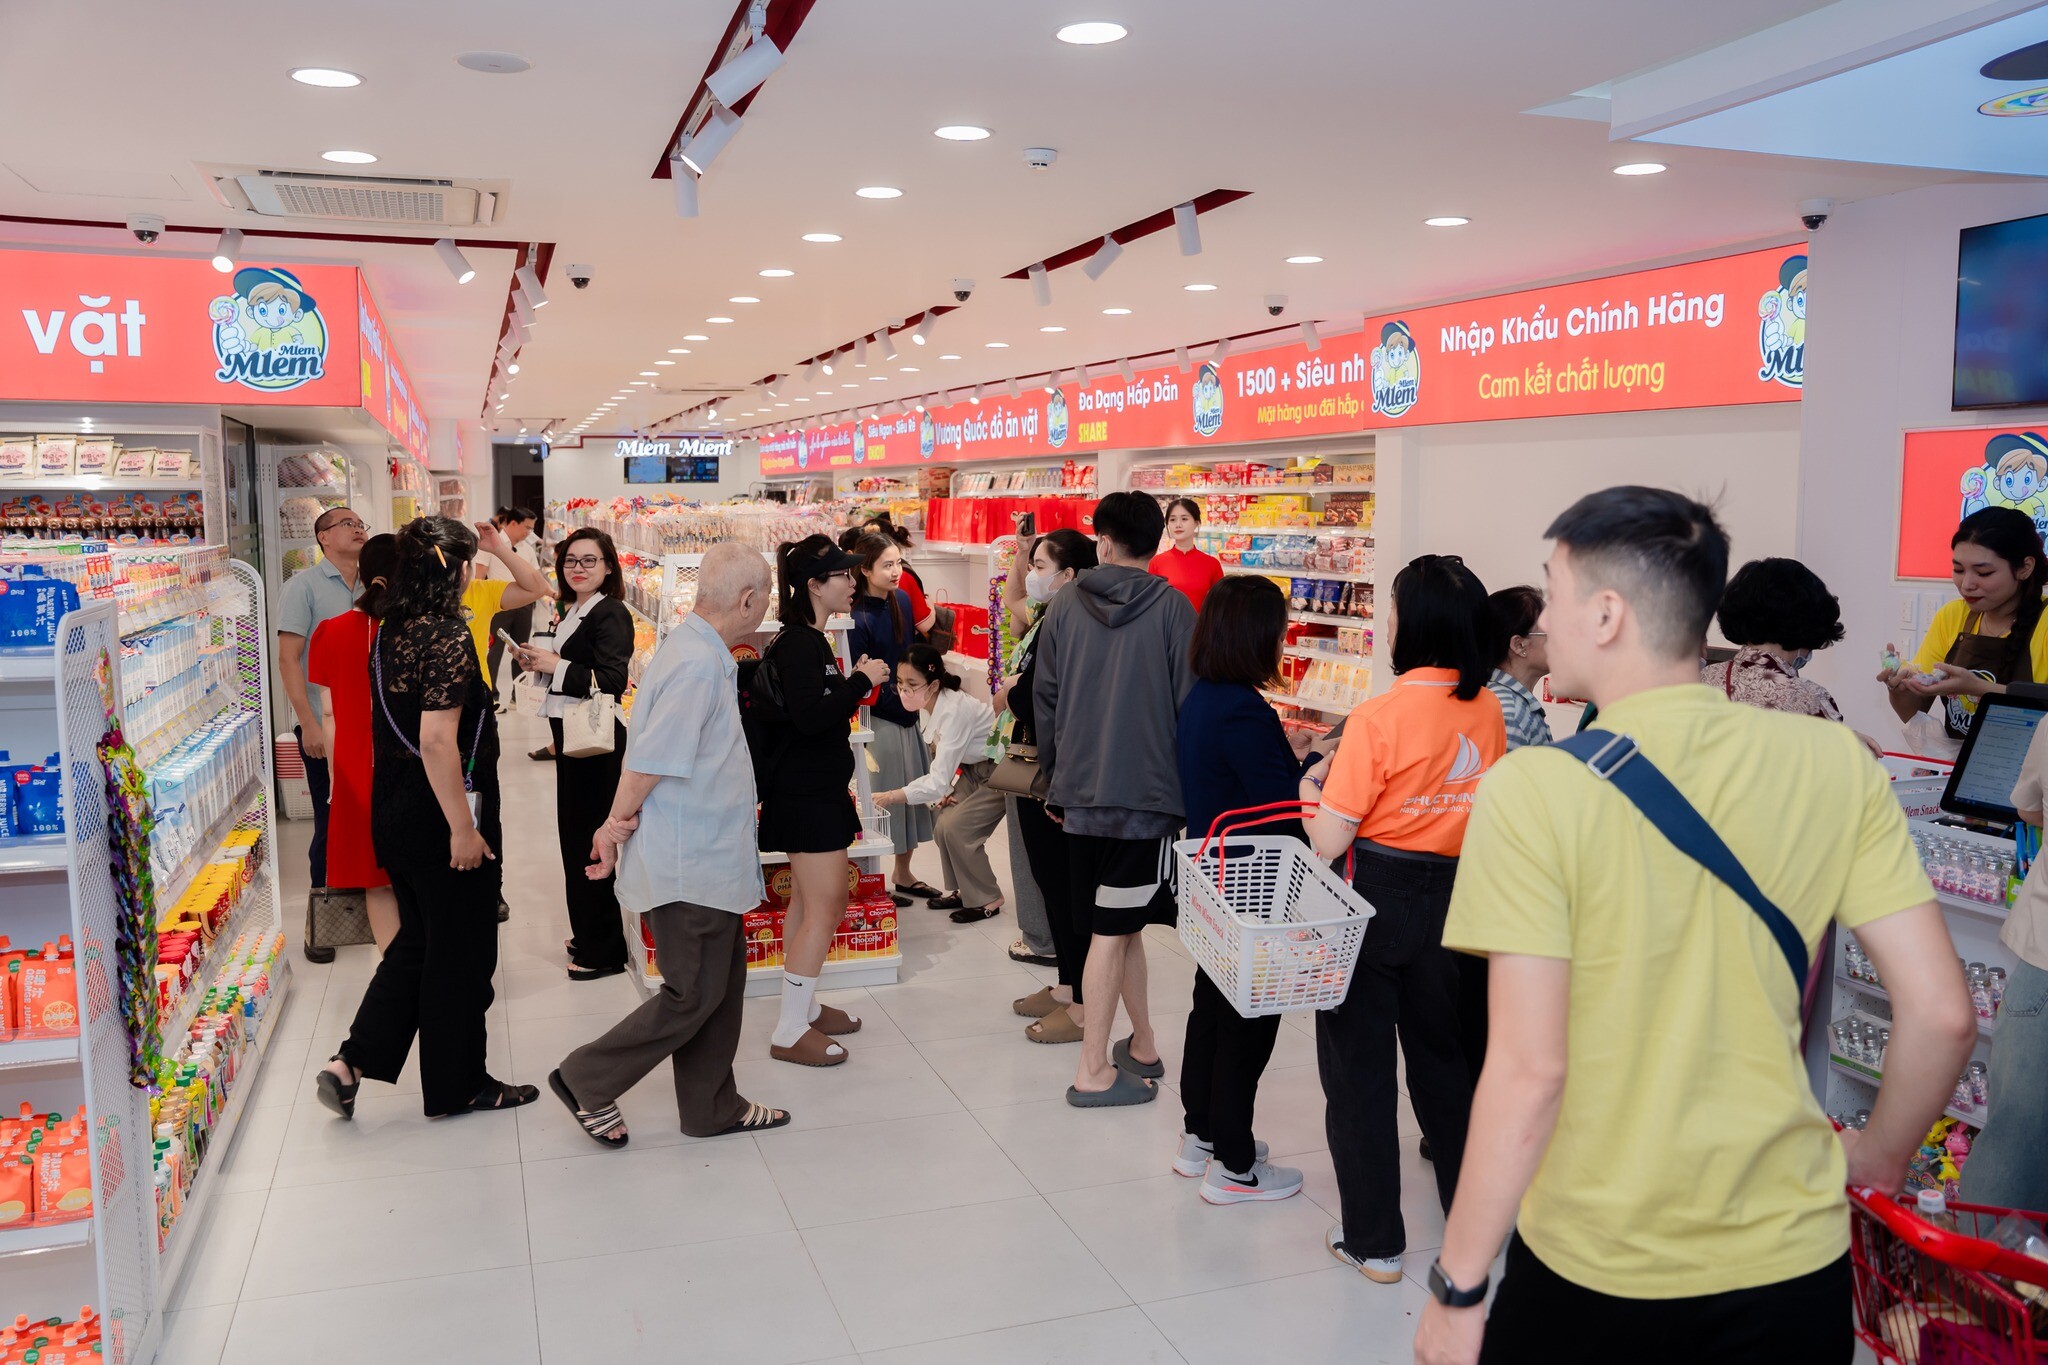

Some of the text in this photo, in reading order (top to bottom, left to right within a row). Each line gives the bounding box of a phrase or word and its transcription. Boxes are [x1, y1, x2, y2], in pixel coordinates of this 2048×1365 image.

[22, 294, 146, 373] vặt
[1441, 292, 1725, 357] Nhập Khẩu Chính Hãng
[219, 350, 321, 379] Mlem
[279, 345, 316, 356] Mlem
[1237, 366, 1276, 397] 1500
[1281, 372, 1291, 391] +
[1296, 356, 1335, 389] Siêu
[1479, 356, 1665, 399] Cam kết chất lượng
[1078, 374, 1178, 414] Đa Dạng Hấp Dẫn
[1277, 404, 1302, 424] hàng
[1319, 398, 1336, 416] đãi
[1337, 393, 1359, 418] hấp
[1373, 385, 1416, 410] Mlem
[935, 405, 1038, 450] Vương Quốc đồ ăn vặt
[1078, 421, 1108, 443] SHARE
[1194, 411, 1222, 431] Mlem
[33, 824, 59, 832] 100%
[851, 936, 882, 944] ChocoPie
